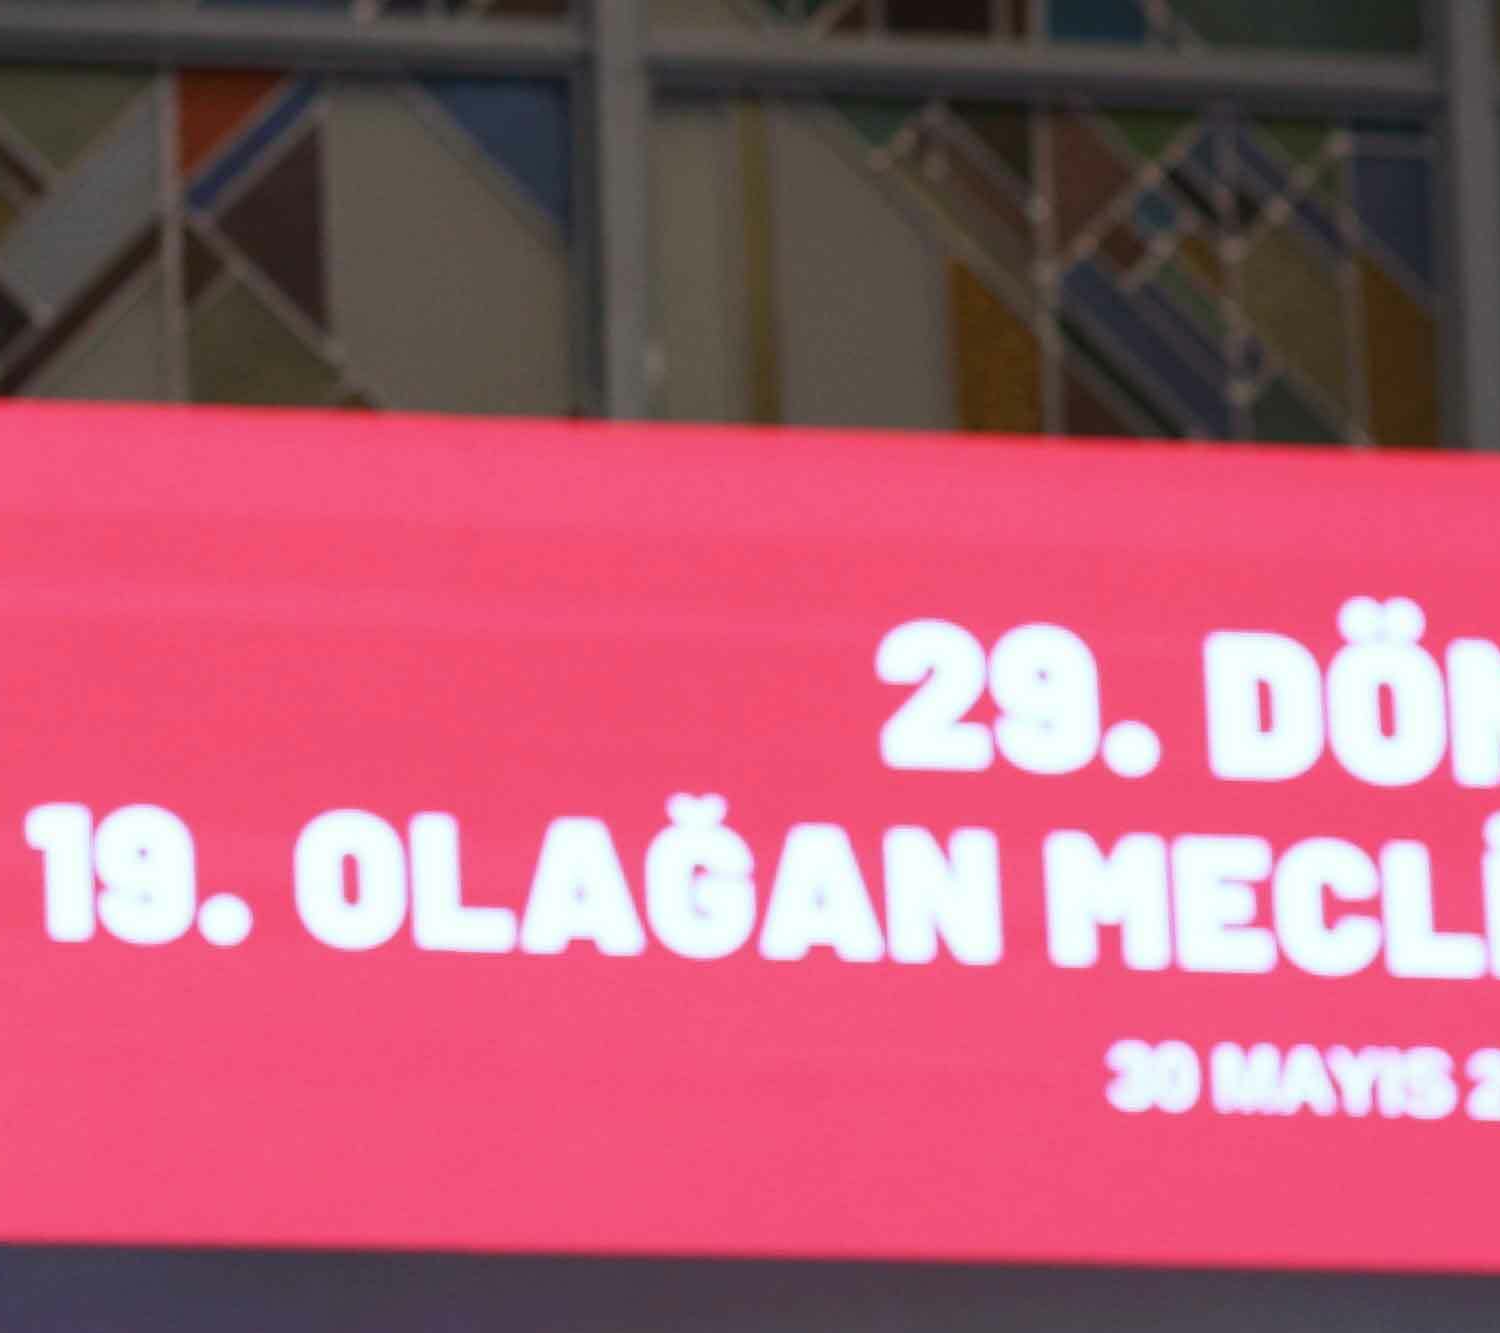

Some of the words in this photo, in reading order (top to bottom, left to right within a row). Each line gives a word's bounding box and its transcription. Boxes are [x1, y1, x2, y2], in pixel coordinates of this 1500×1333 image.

[877, 620, 1160, 776] 29.
[25, 804, 252, 945] 19.
[295, 794, 1002, 965] OLAĞAN
[1108, 1040, 1200, 1112] 30
[1212, 1043, 1456, 1118] MAYIS
